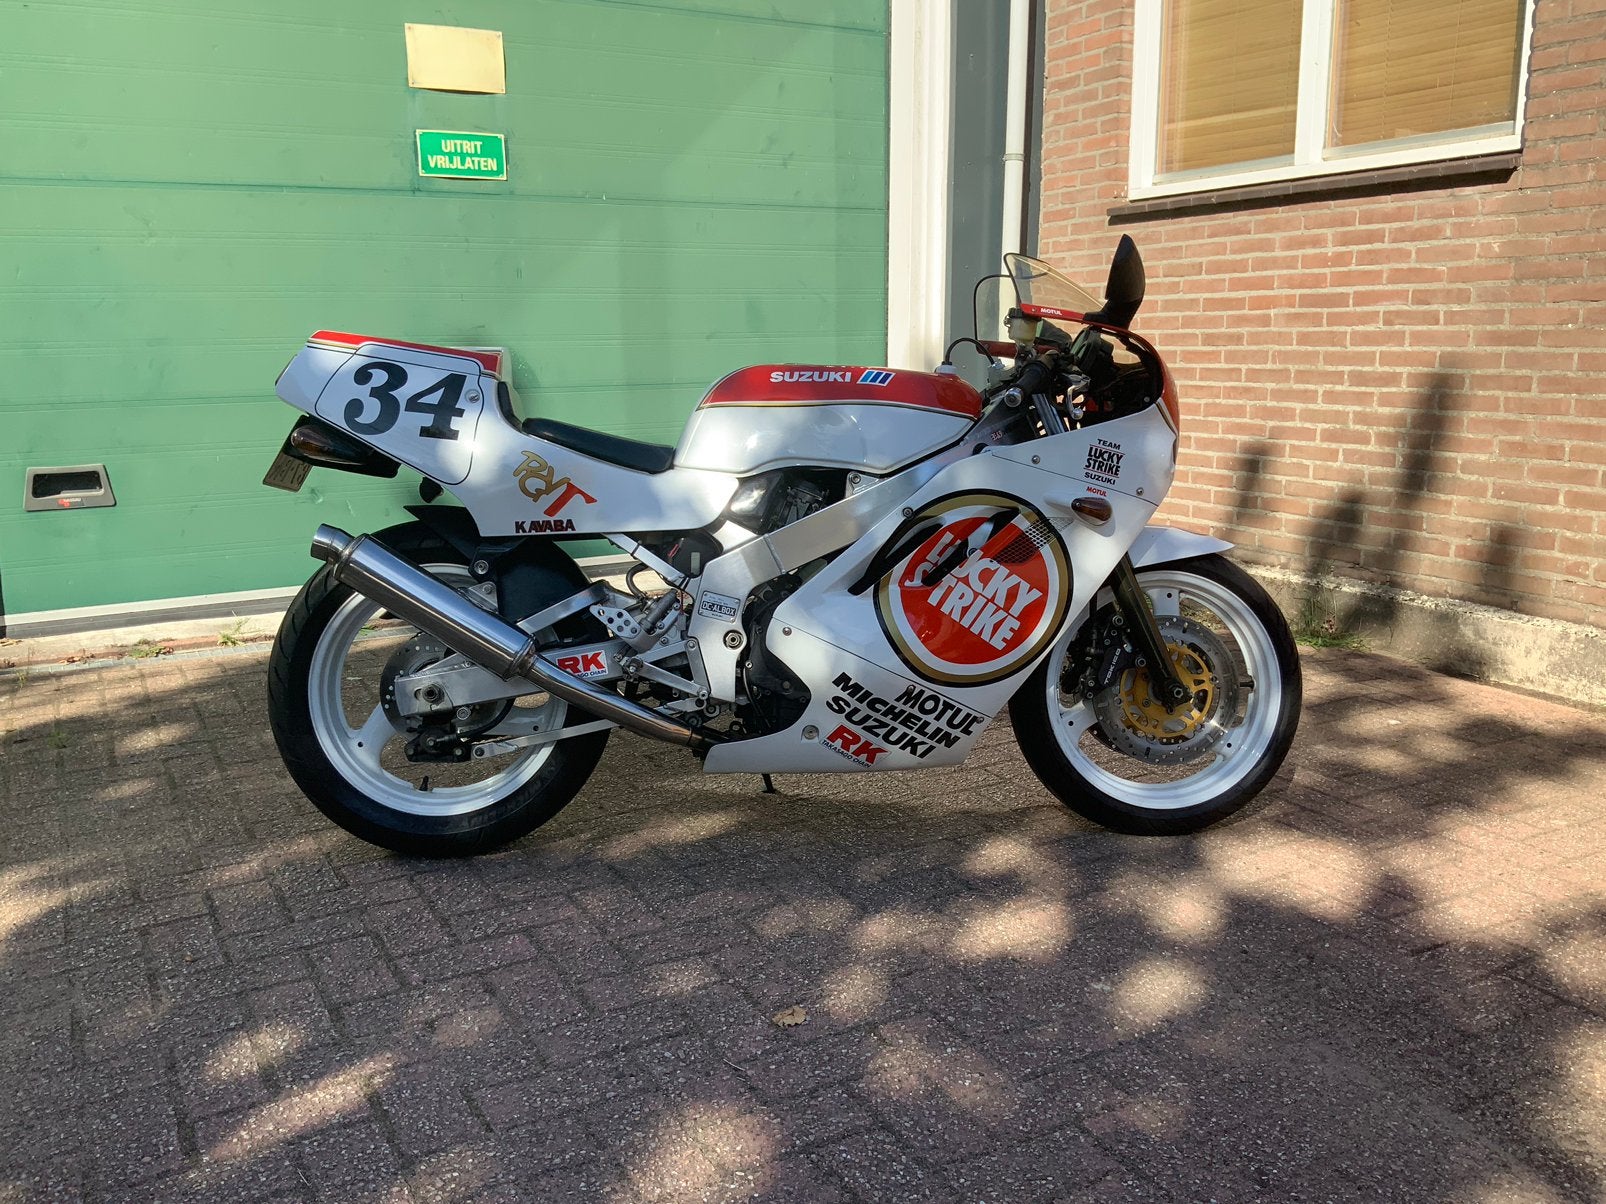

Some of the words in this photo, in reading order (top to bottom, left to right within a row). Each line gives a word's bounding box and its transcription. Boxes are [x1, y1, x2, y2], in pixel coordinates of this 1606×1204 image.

[441, 139, 483, 155] UITRIT
[428, 154, 498, 171] VRIJLATEN
[1040, 307, 1063, 316] MOTUL
[769, 371, 852, 383] SUZUKI
[344, 361, 467, 441] 34
[1097, 438, 1121, 451] TEAM
[1088, 446, 1124, 465] LUCKY
[1084, 457, 1121, 476] STRIKE
[1084, 471, 1116, 485] SUZUKI
[1086, 486, 1107, 497] MOTUL
[557, 651, 606, 674] RK
[831, 671, 961, 749] MICHELIN
[894, 685, 978, 736] MOTUL
[826, 695, 936, 759] SUZUKI
[822, 739, 853, 760] TAKASAGO
[852, 757, 871, 768] CHAIN
[826, 724, 889, 765] RK
